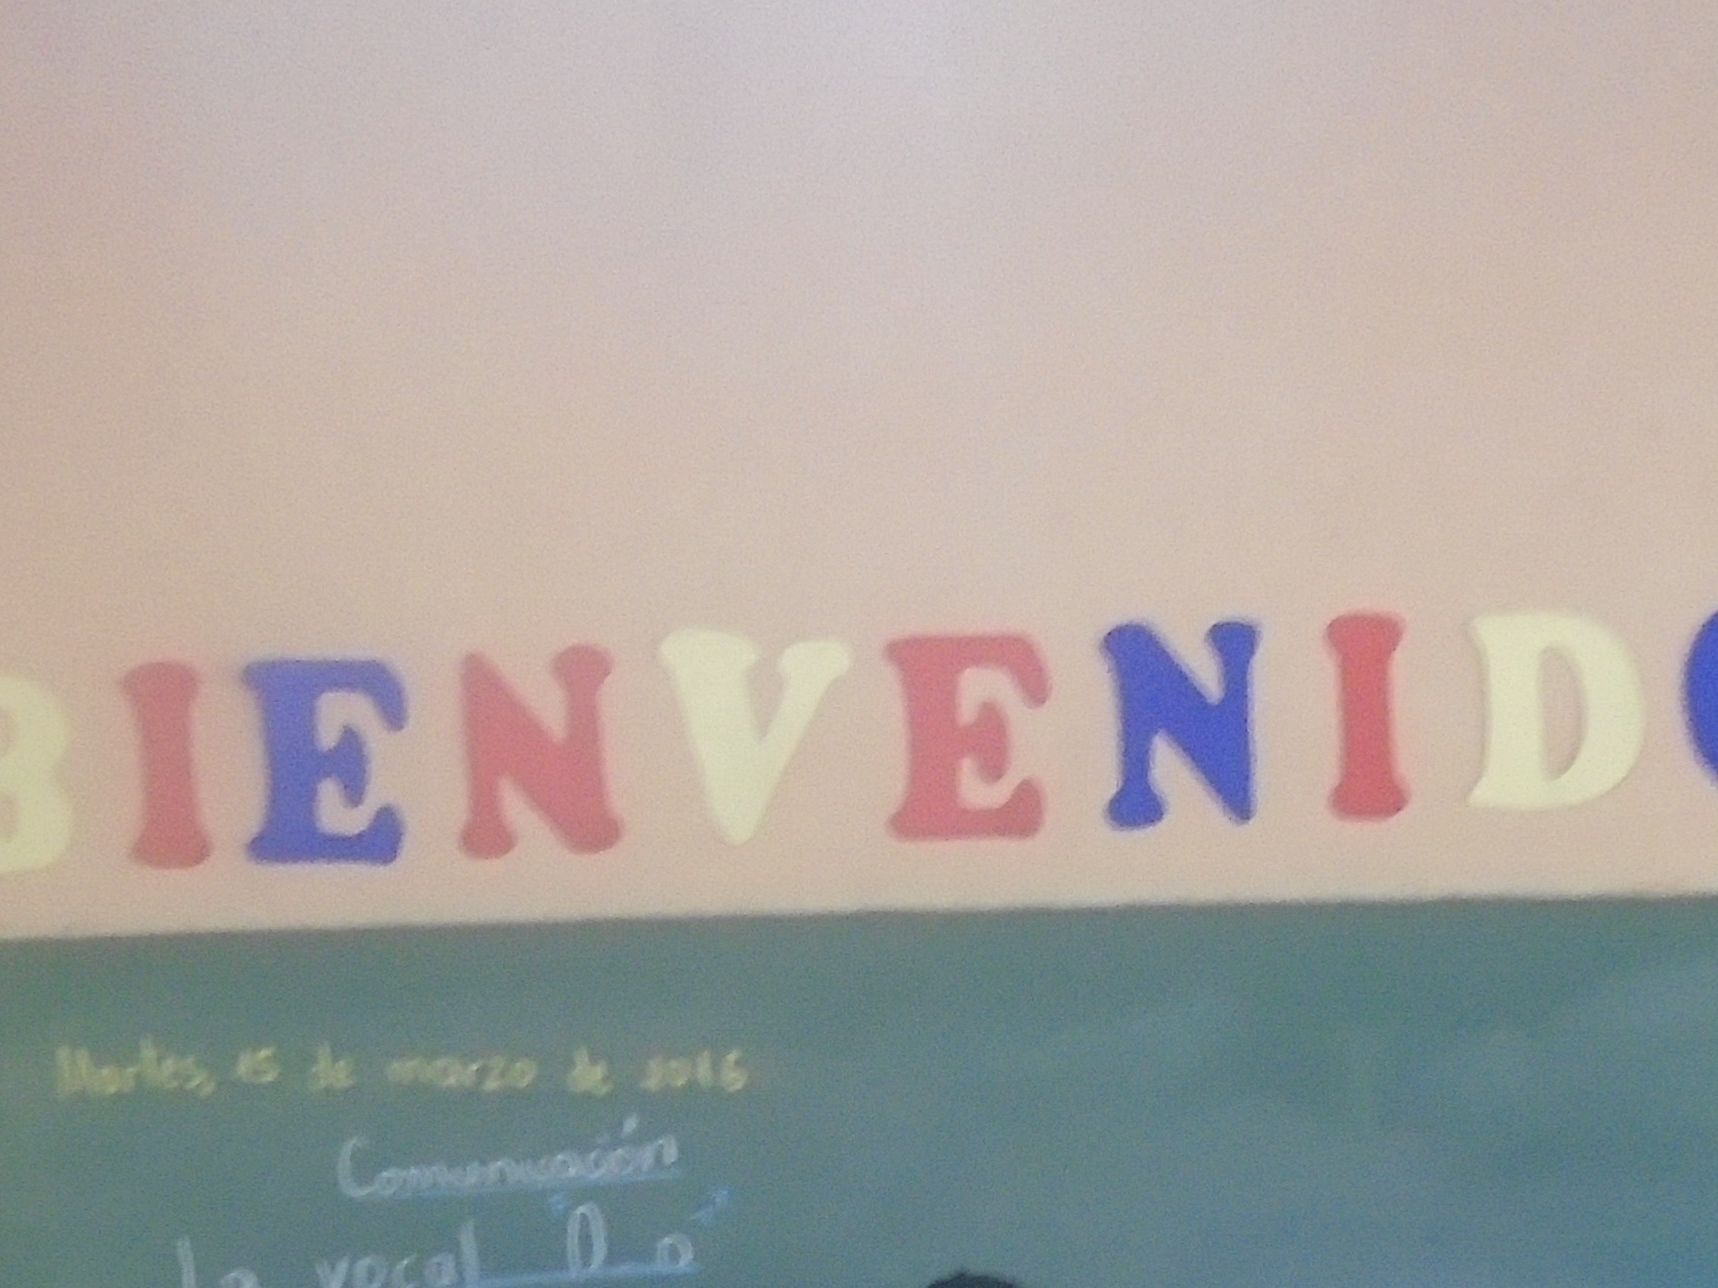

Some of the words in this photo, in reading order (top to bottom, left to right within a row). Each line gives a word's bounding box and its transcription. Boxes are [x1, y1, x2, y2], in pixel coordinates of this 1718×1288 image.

[309, 1044, 357, 1093] de
[387, 1054, 539, 1092] marzo
[568, 1047, 613, 1096] de
